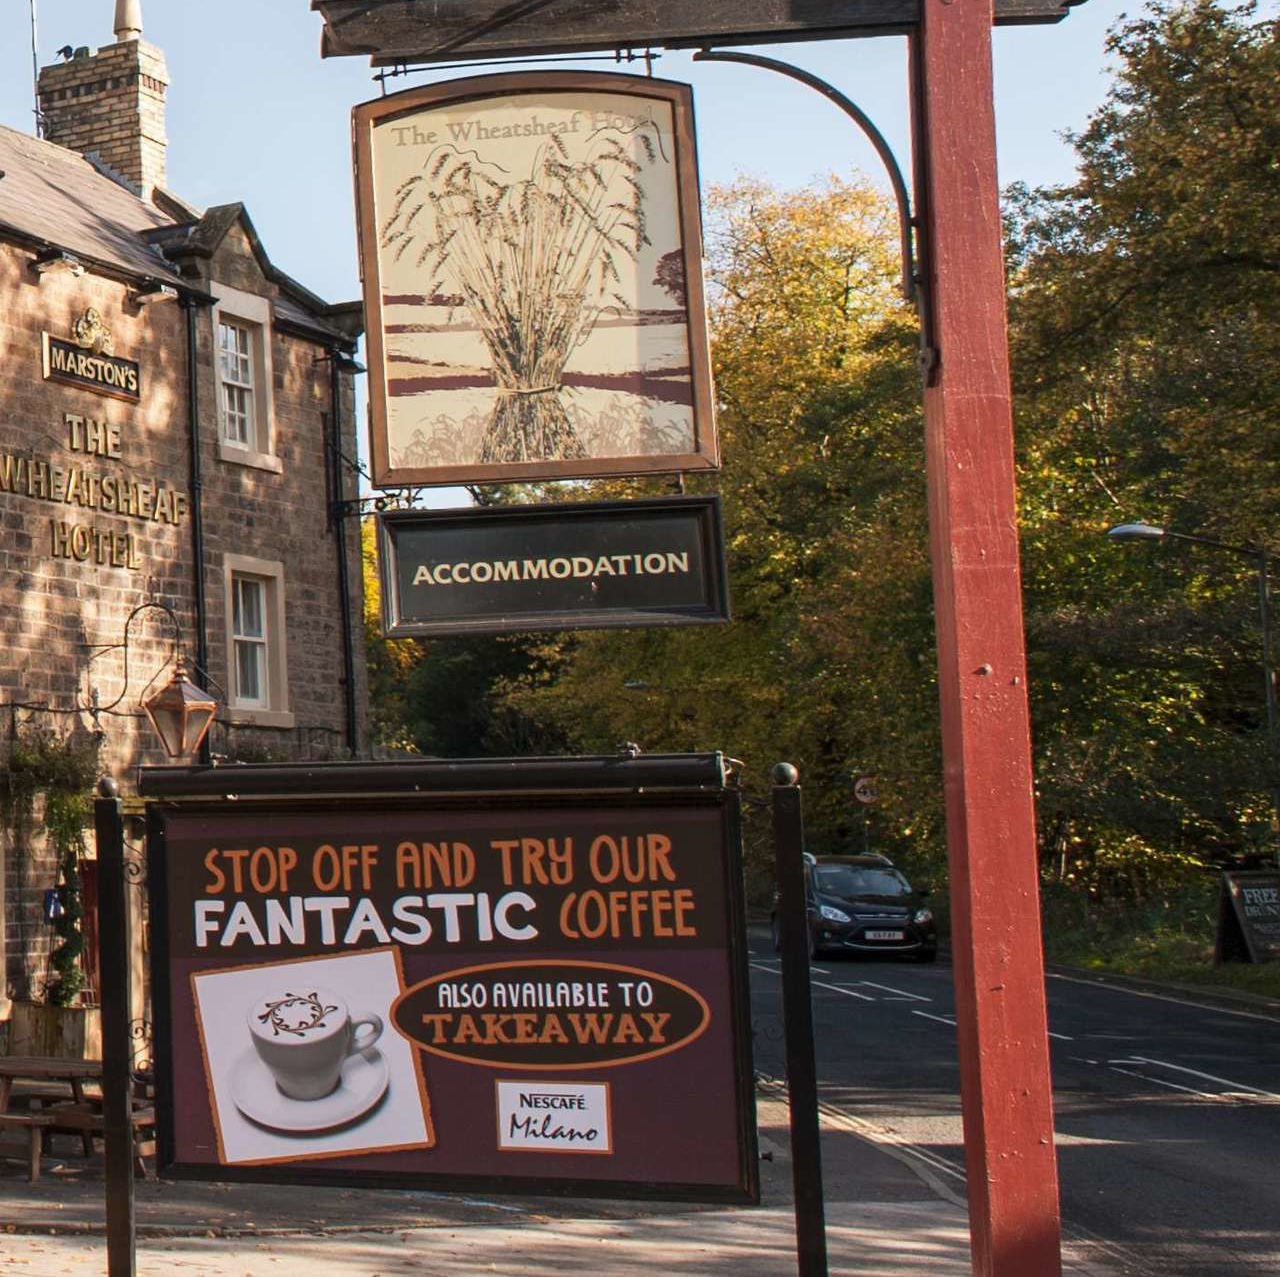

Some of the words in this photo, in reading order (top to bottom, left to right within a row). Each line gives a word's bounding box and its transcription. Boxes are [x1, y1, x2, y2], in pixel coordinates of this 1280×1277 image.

[390, 126, 438, 146] The
[445, 111, 580, 142] Wheatsheaf
[50, 347, 137, 391] MARSTON'S
[63, 412, 122, 460] THE
[49, 518, 143, 570] HOTEL
[411, 551, 689, 585] ACCOMMODATION
[204, 846, 297, 894] STOP
[312, 844, 379, 891] OFF
[396, 841, 475, 889] AND
[490, 837, 574, 886] TRY
[589, 833, 676, 884] OUR
[194, 891, 539, 947] FANTASTIC
[559, 889, 697, 939] COFFEE
[438, 982, 488, 1008] ALSO
[493, 982, 609, 1008] AVAILABLE
[618, 981, 653, 1007] TO
[421, 1012, 672, 1045] TAKEAWAY
[519, 1093, 586, 1110] NESCAFÉ
[509, 1112, 599, 1141] Milano
